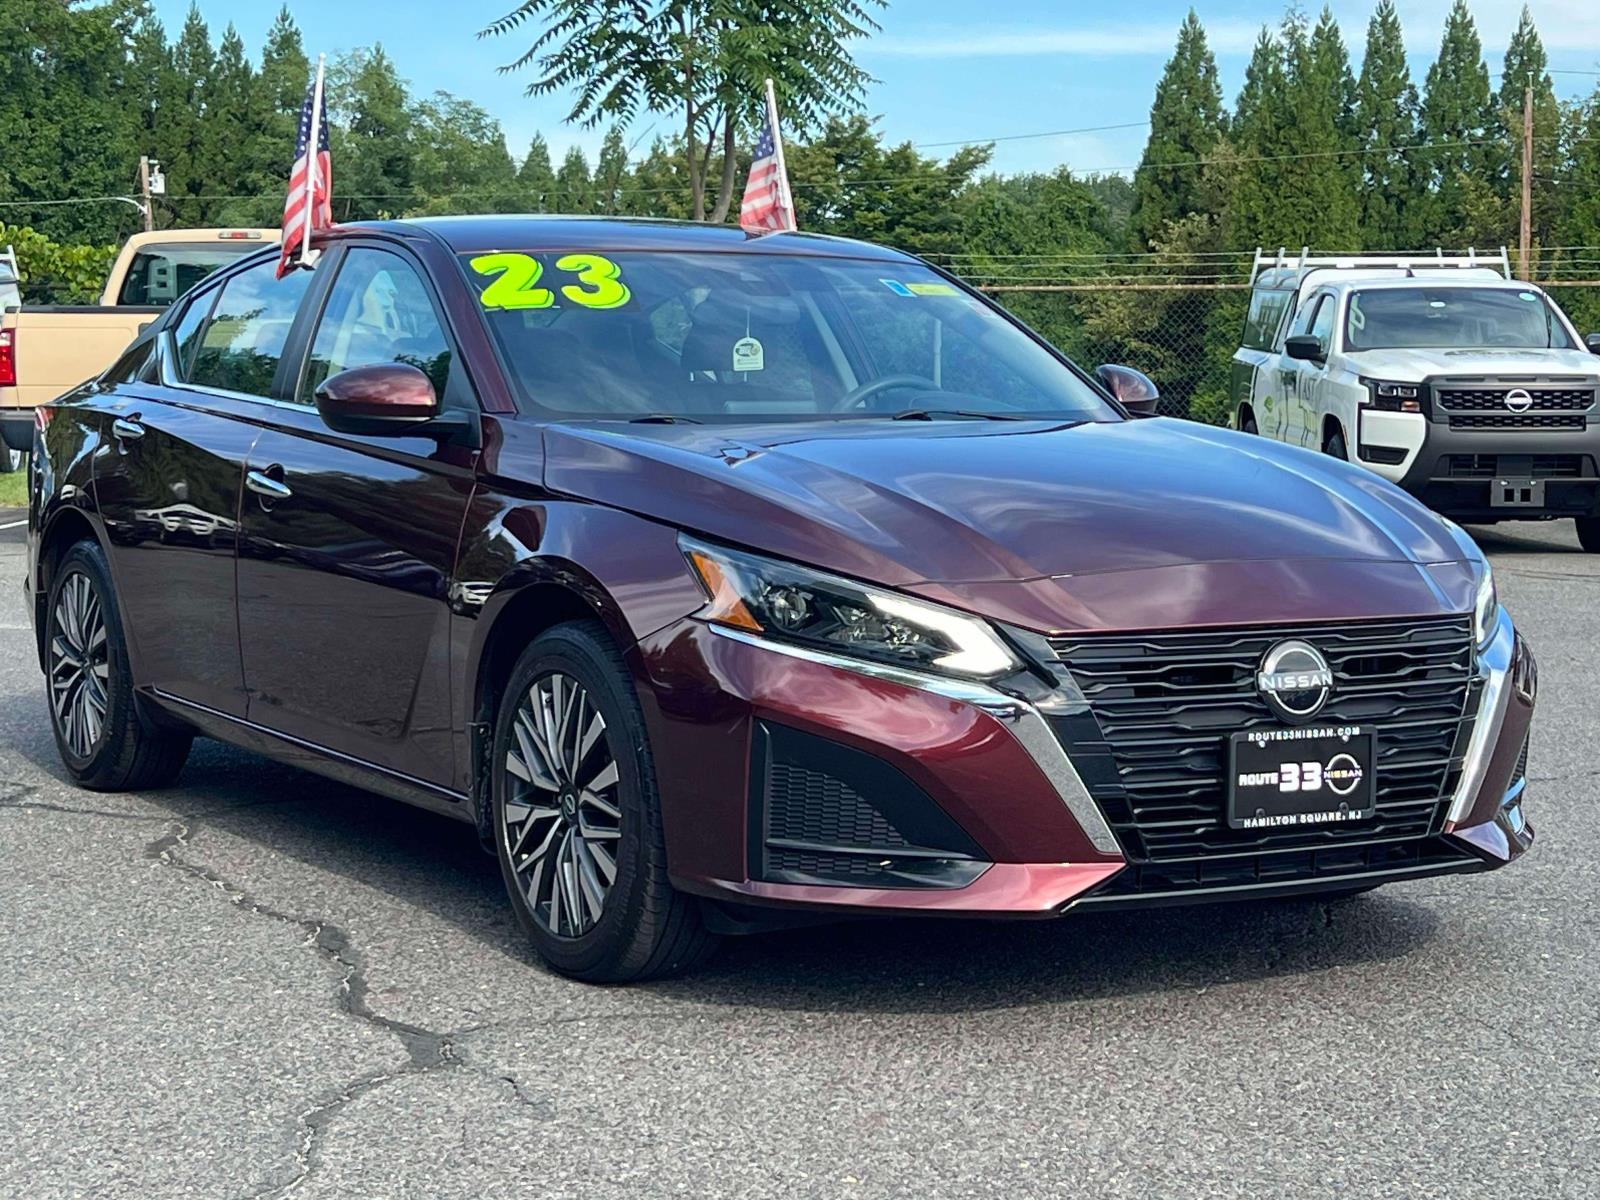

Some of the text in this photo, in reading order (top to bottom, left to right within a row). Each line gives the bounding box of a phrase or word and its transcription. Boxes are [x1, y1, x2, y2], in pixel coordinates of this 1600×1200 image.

[470, 253, 631, 309] 23
[1261, 673, 1333, 689] NISSAN
[1248, 727, 1360, 741] ROUTE33NISSAN.COM
[1239, 762, 1322, 793] ROUTE 33
[1324, 768, 1363, 779] NISSAN
[1244, 810, 1362, 828] HAMILTON SQUARE, NJ
